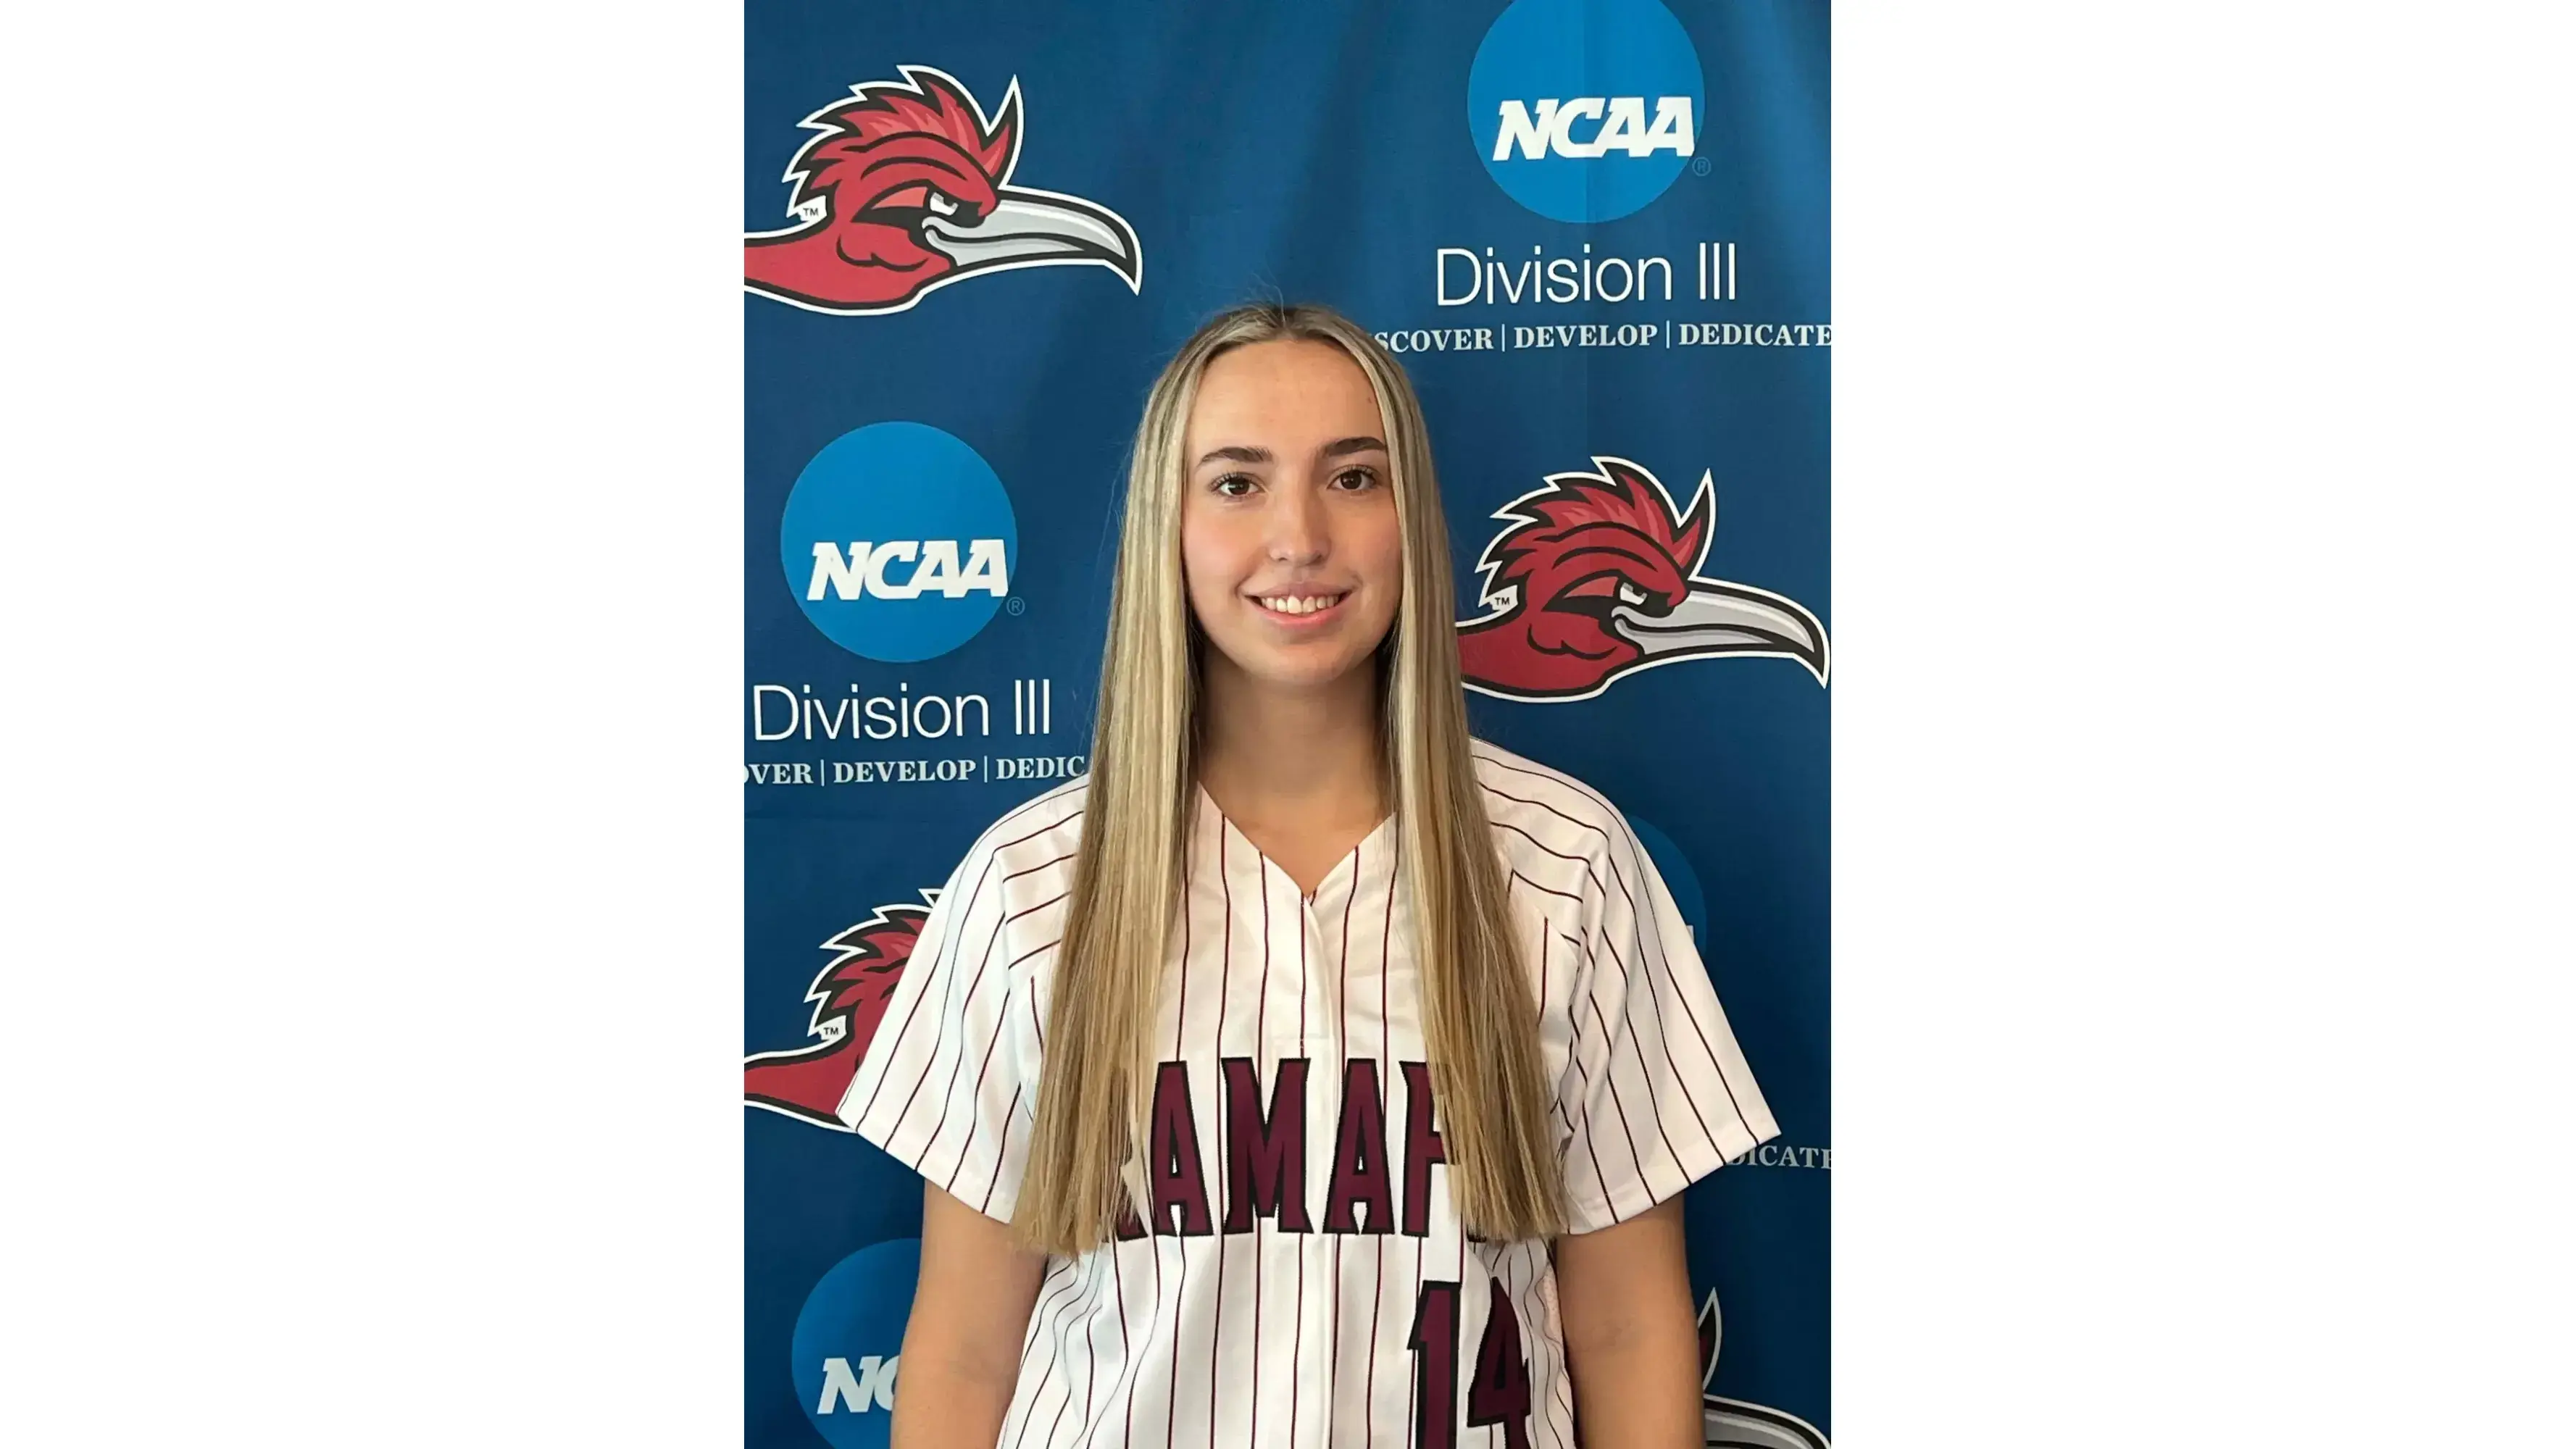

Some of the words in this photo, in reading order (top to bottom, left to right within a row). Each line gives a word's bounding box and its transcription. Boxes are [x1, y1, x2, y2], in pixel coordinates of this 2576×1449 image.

[1493, 97, 1694, 160] NCAA
[803, 207, 819, 217] TM
[1437, 243, 1672, 306] Division
[1699, 242, 1735, 300] III
[1372, 328, 1494, 353] SCOVER
[1514, 325, 1658, 348] DEVELOP
[1679, 323, 1831, 346] DEDICATE
[806, 539, 1009, 601] NCAA
[1494, 596, 1510, 606] TM
[754, 682, 989, 740] Division
[1015, 679, 1051, 735] III
[744, 763, 814, 784] VER
[833, 759, 976, 783] DEVELOP
[996, 756, 1085, 780] DEDIC
[823, 1027, 839, 1035] TM
[1406, 1276, 1532, 1449] 14
